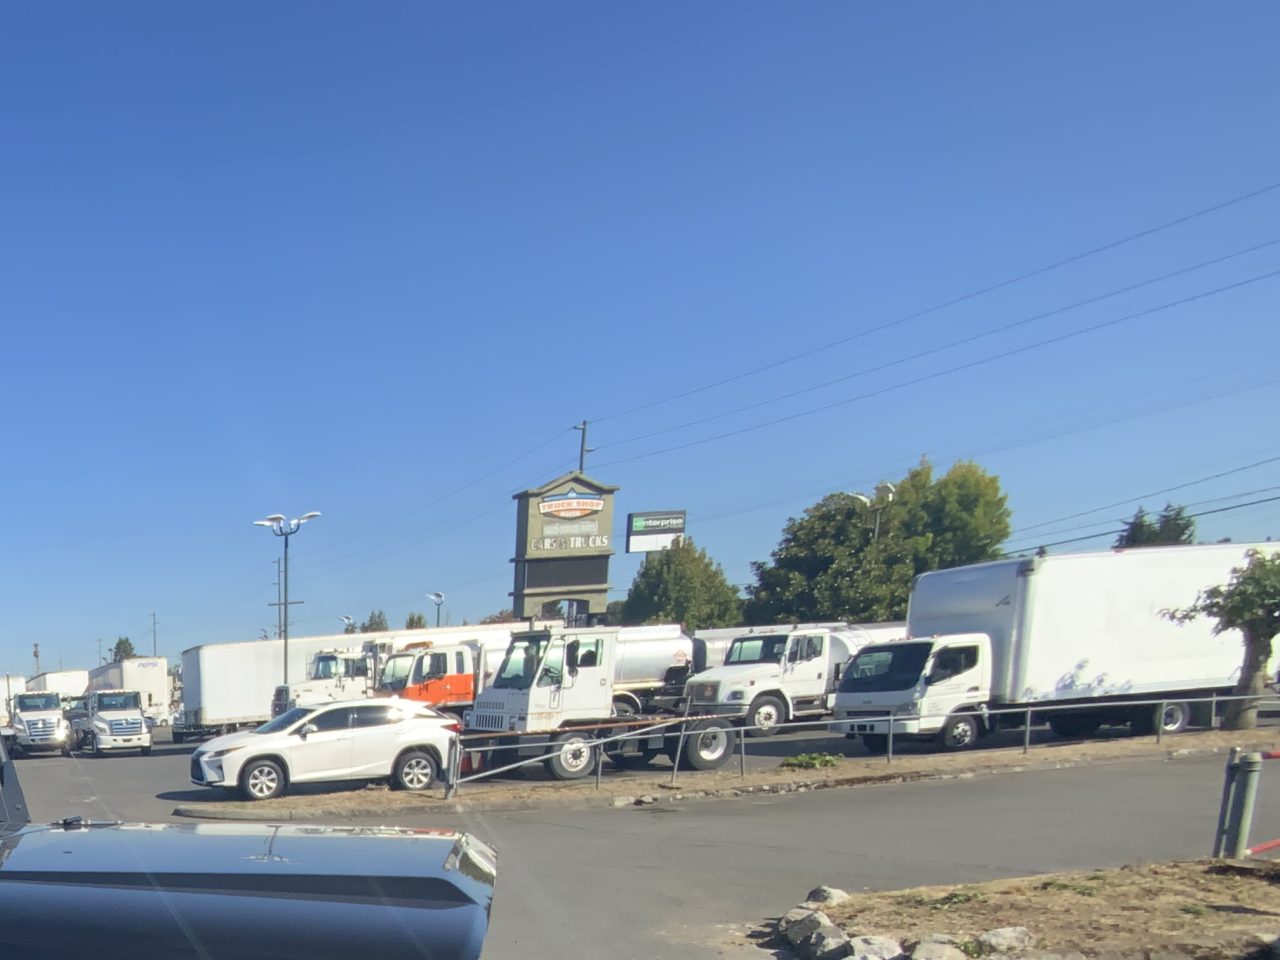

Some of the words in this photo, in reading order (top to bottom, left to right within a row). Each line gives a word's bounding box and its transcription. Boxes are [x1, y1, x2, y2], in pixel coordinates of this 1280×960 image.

[542, 501, 573, 511] TRUCK
[575, 500, 602, 509] SHOP
[531, 538, 557, 550] CARS
[570, 535, 609, 549] TRUCKS
